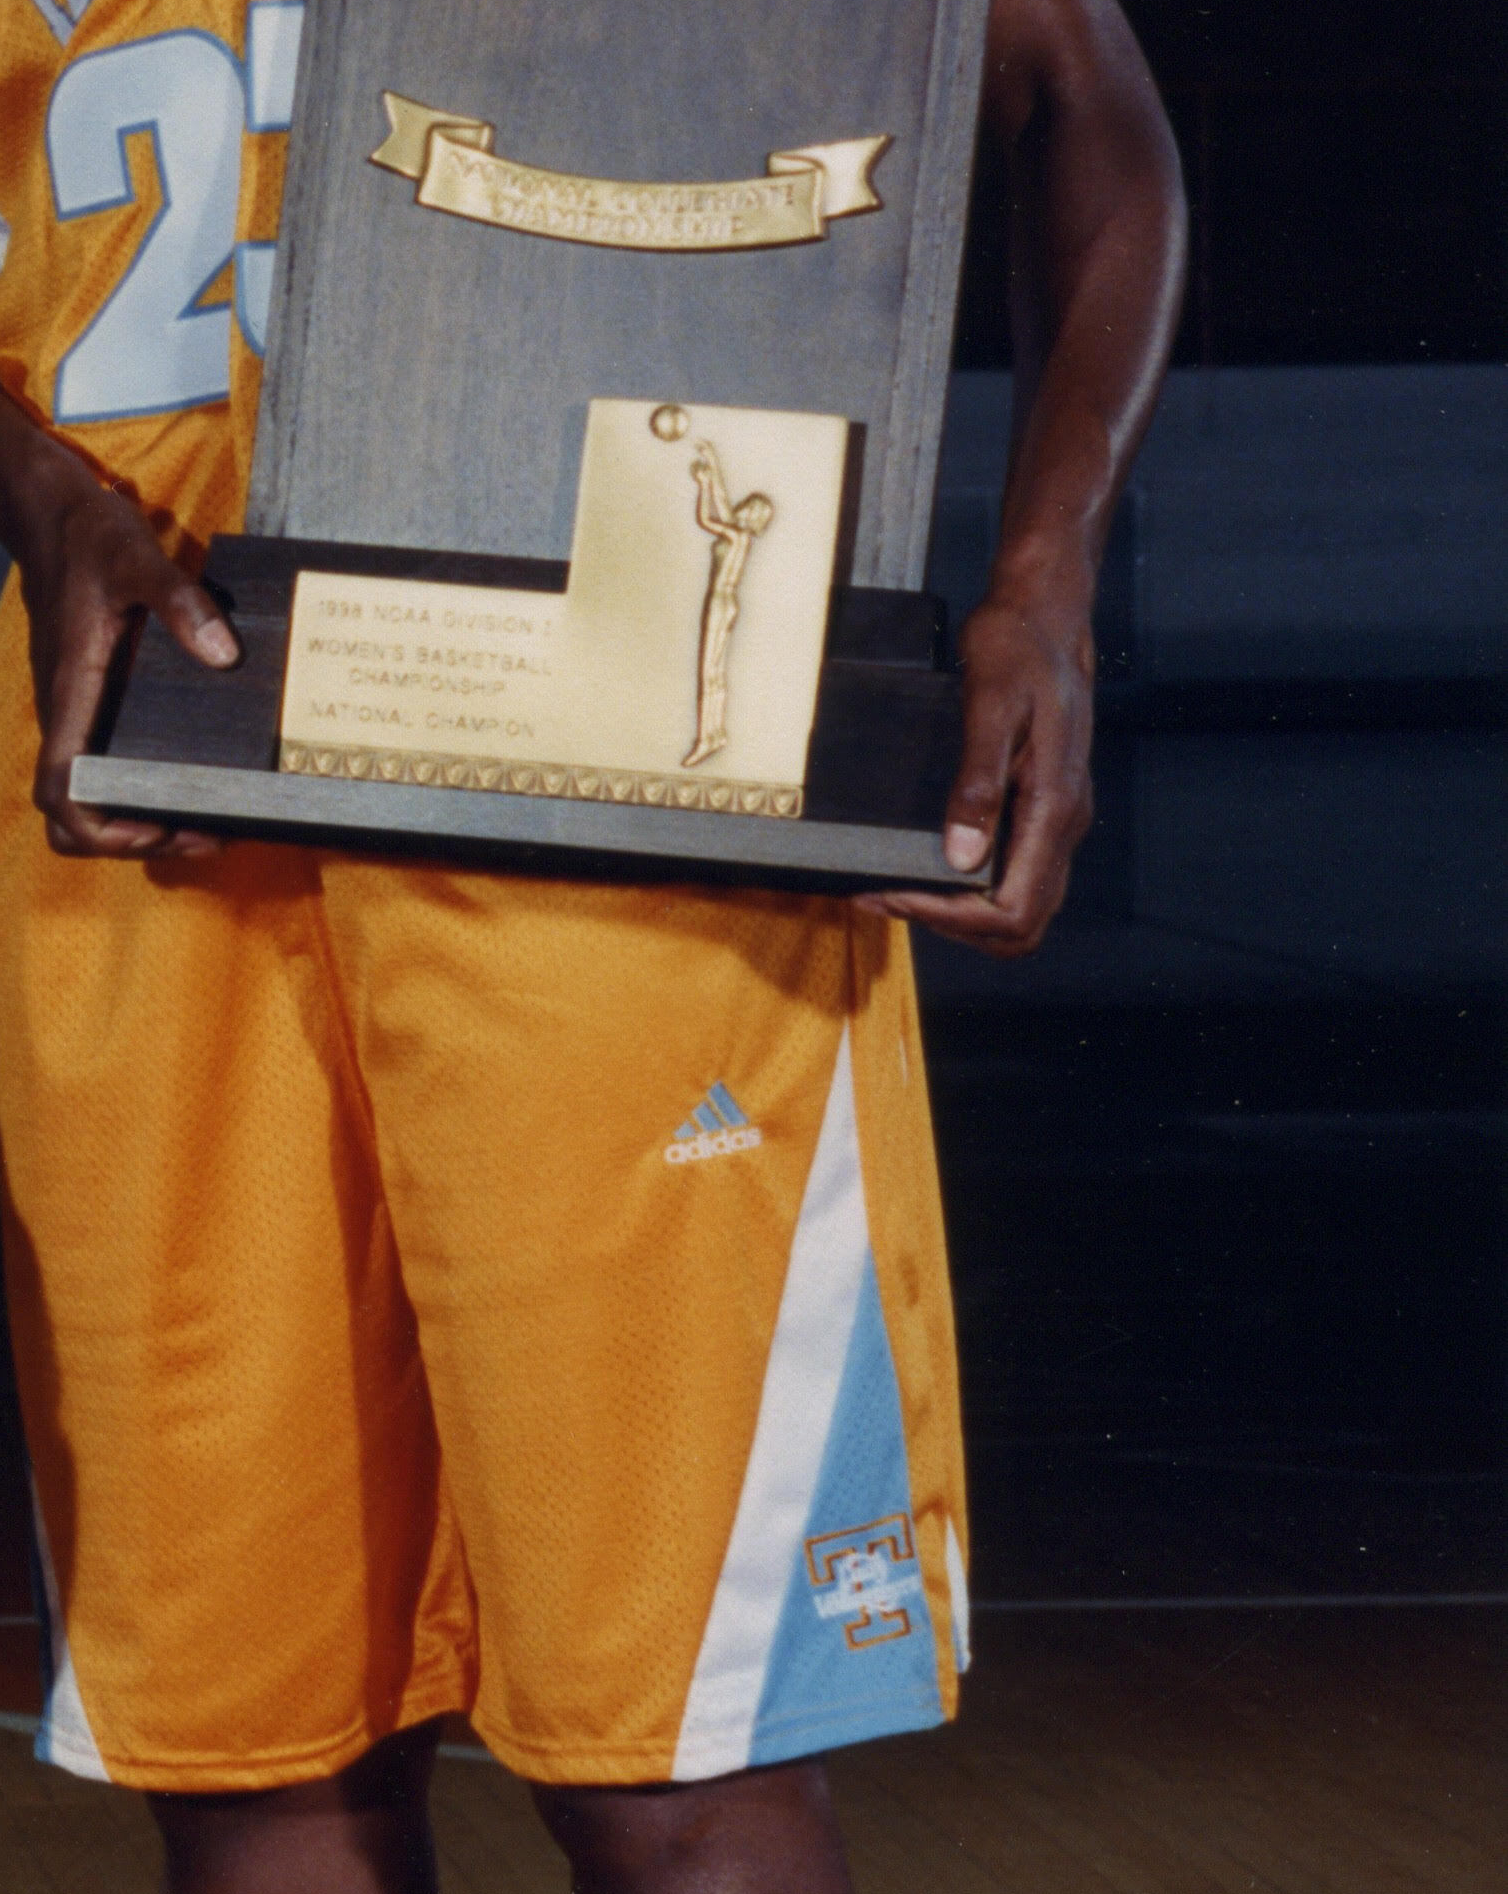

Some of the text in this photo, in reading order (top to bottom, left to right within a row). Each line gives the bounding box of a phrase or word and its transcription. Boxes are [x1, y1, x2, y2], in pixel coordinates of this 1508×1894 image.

[374, 604, 431, 624] NCAA
[416, 645, 553, 677] BASKETBALL
[349, 666, 506, 696] CHAMPIONSHIP
[310, 700, 536, 738] NATIONAL CHAMPION
[665, 1127, 762, 1164] adidas
